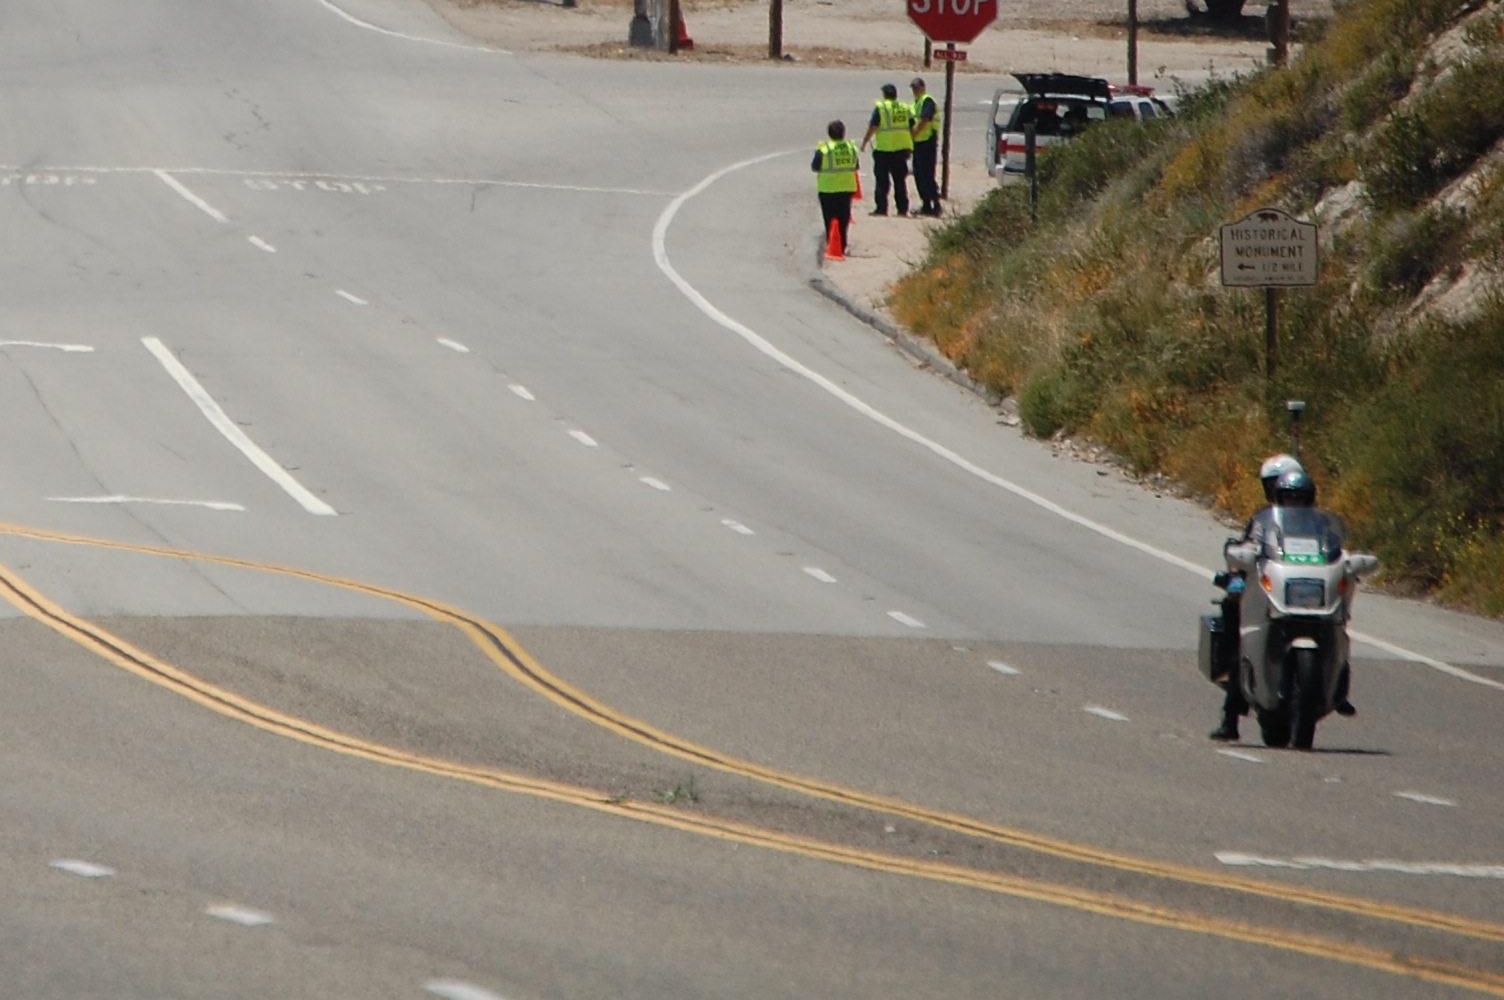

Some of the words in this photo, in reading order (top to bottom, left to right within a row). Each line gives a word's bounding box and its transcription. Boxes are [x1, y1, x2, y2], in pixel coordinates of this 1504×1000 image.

[1230, 228, 1307, 241] HISTORICAL
[1235, 245, 1304, 258] MONUMENT
[1262, 262, 1278, 273] 1/2
[1281, 262, 1304, 273] MILE
